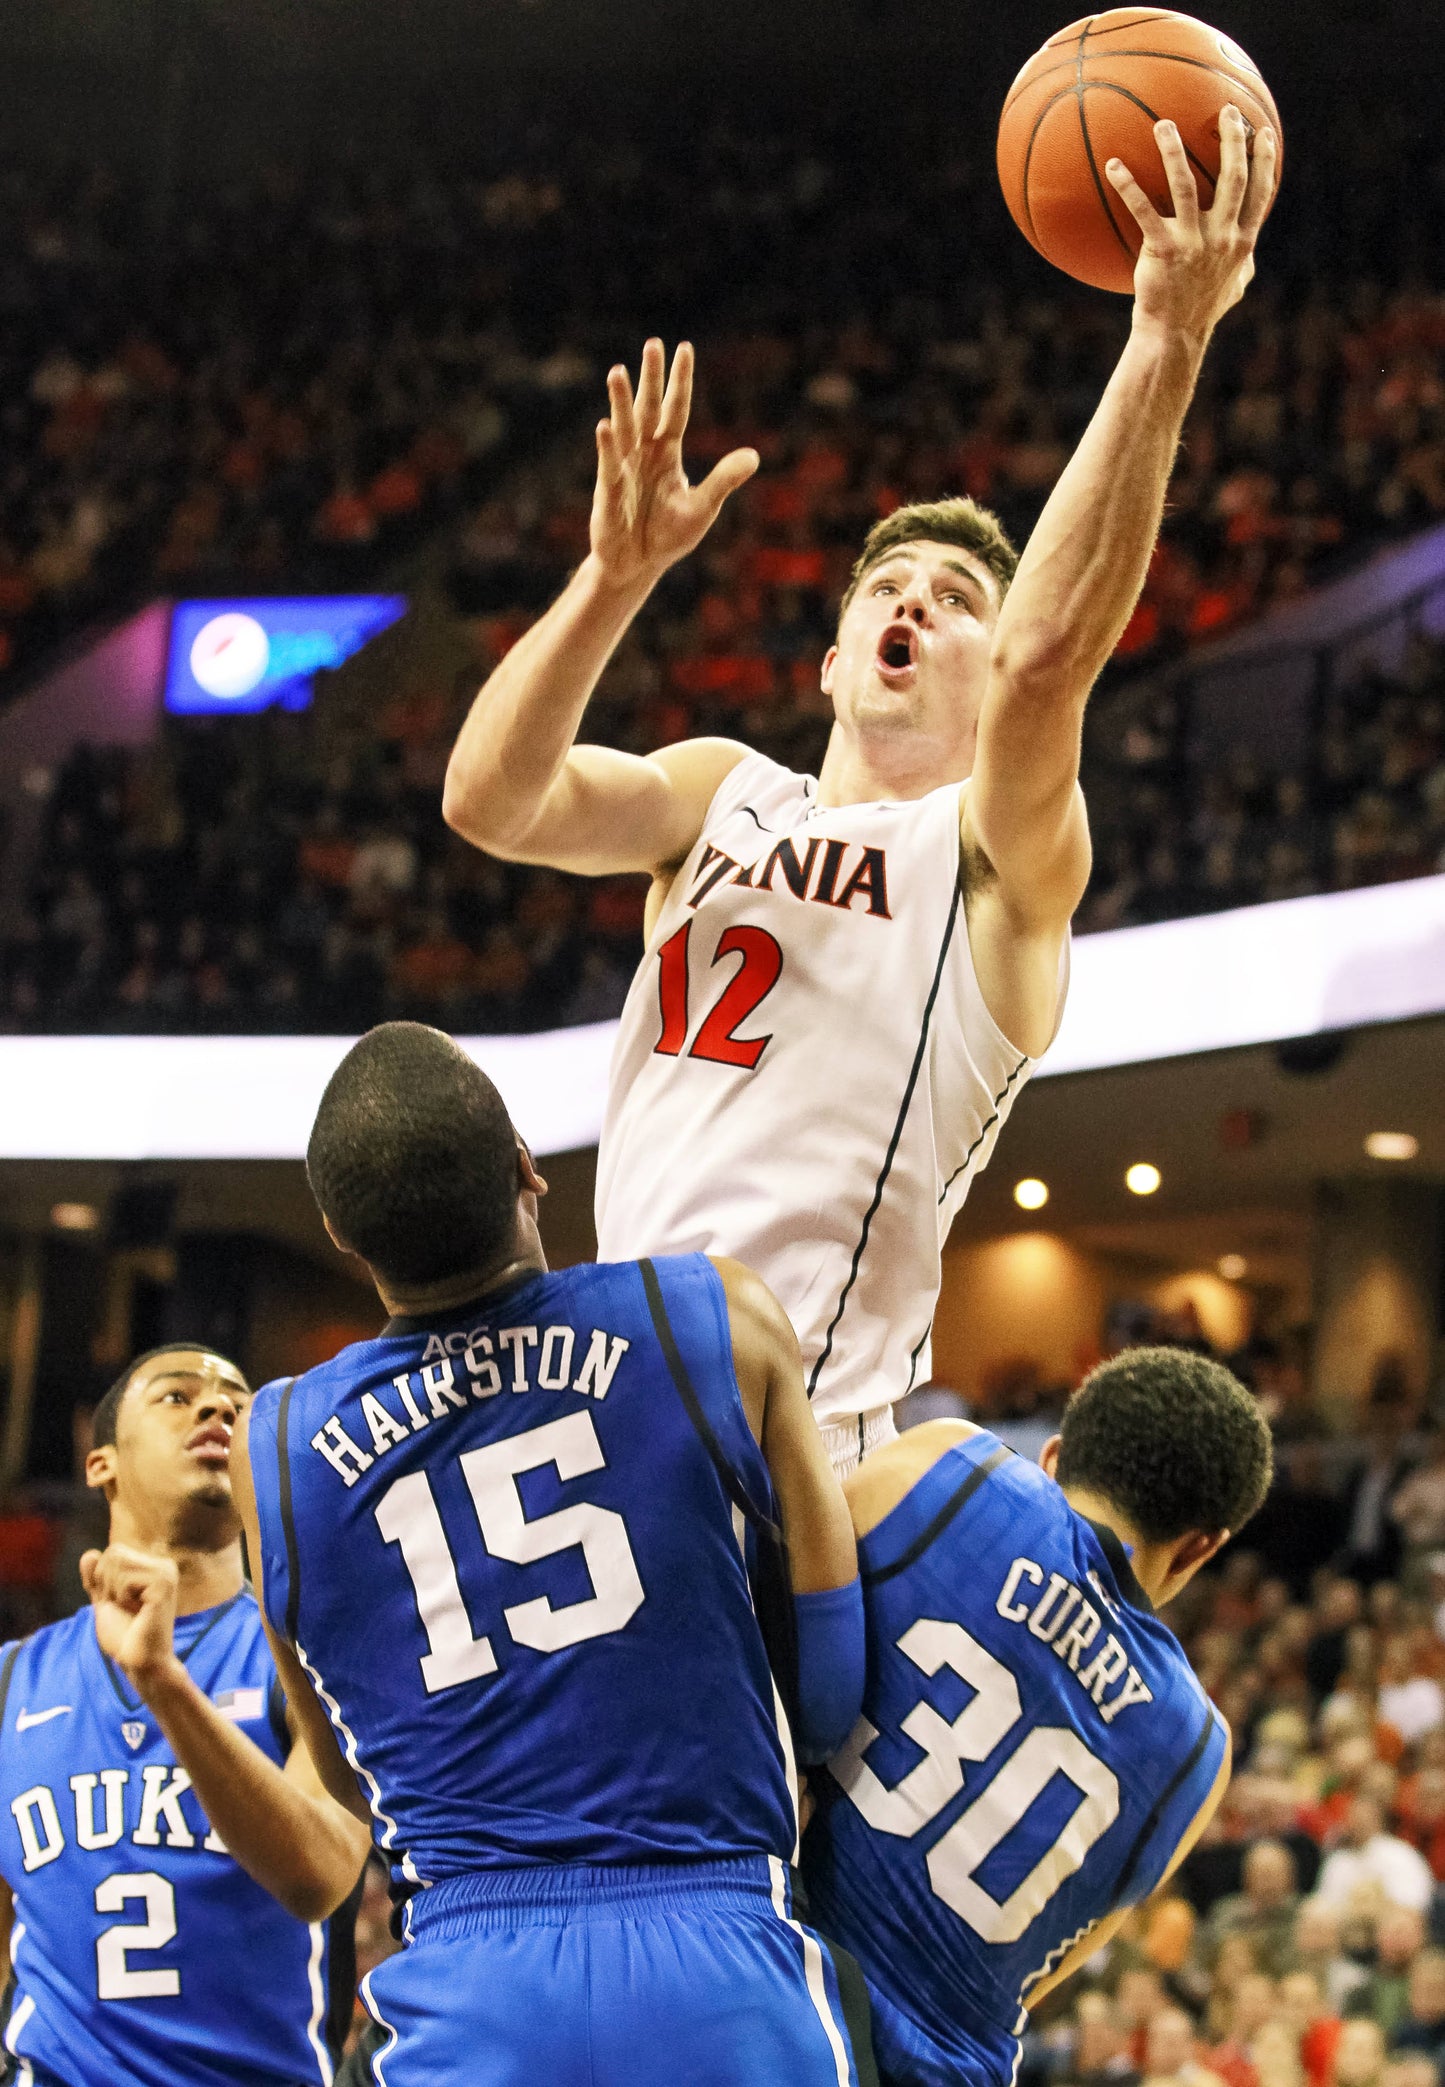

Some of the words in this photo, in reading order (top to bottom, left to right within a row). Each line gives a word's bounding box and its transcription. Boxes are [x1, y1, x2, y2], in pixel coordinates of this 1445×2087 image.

[687, 837, 892, 920] VINIA
[653, 917, 784, 1070] 12
[310, 1325, 630, 1488] HAIRSTON
[422, 1326, 489, 1361] ACC
[373, 1408, 646, 1693] 15
[995, 1556, 1154, 1723] CURRY
[10, 1765, 230, 1873] DUK
[827, 1617, 1120, 1944] 30
[94, 1871, 181, 2000] 2
